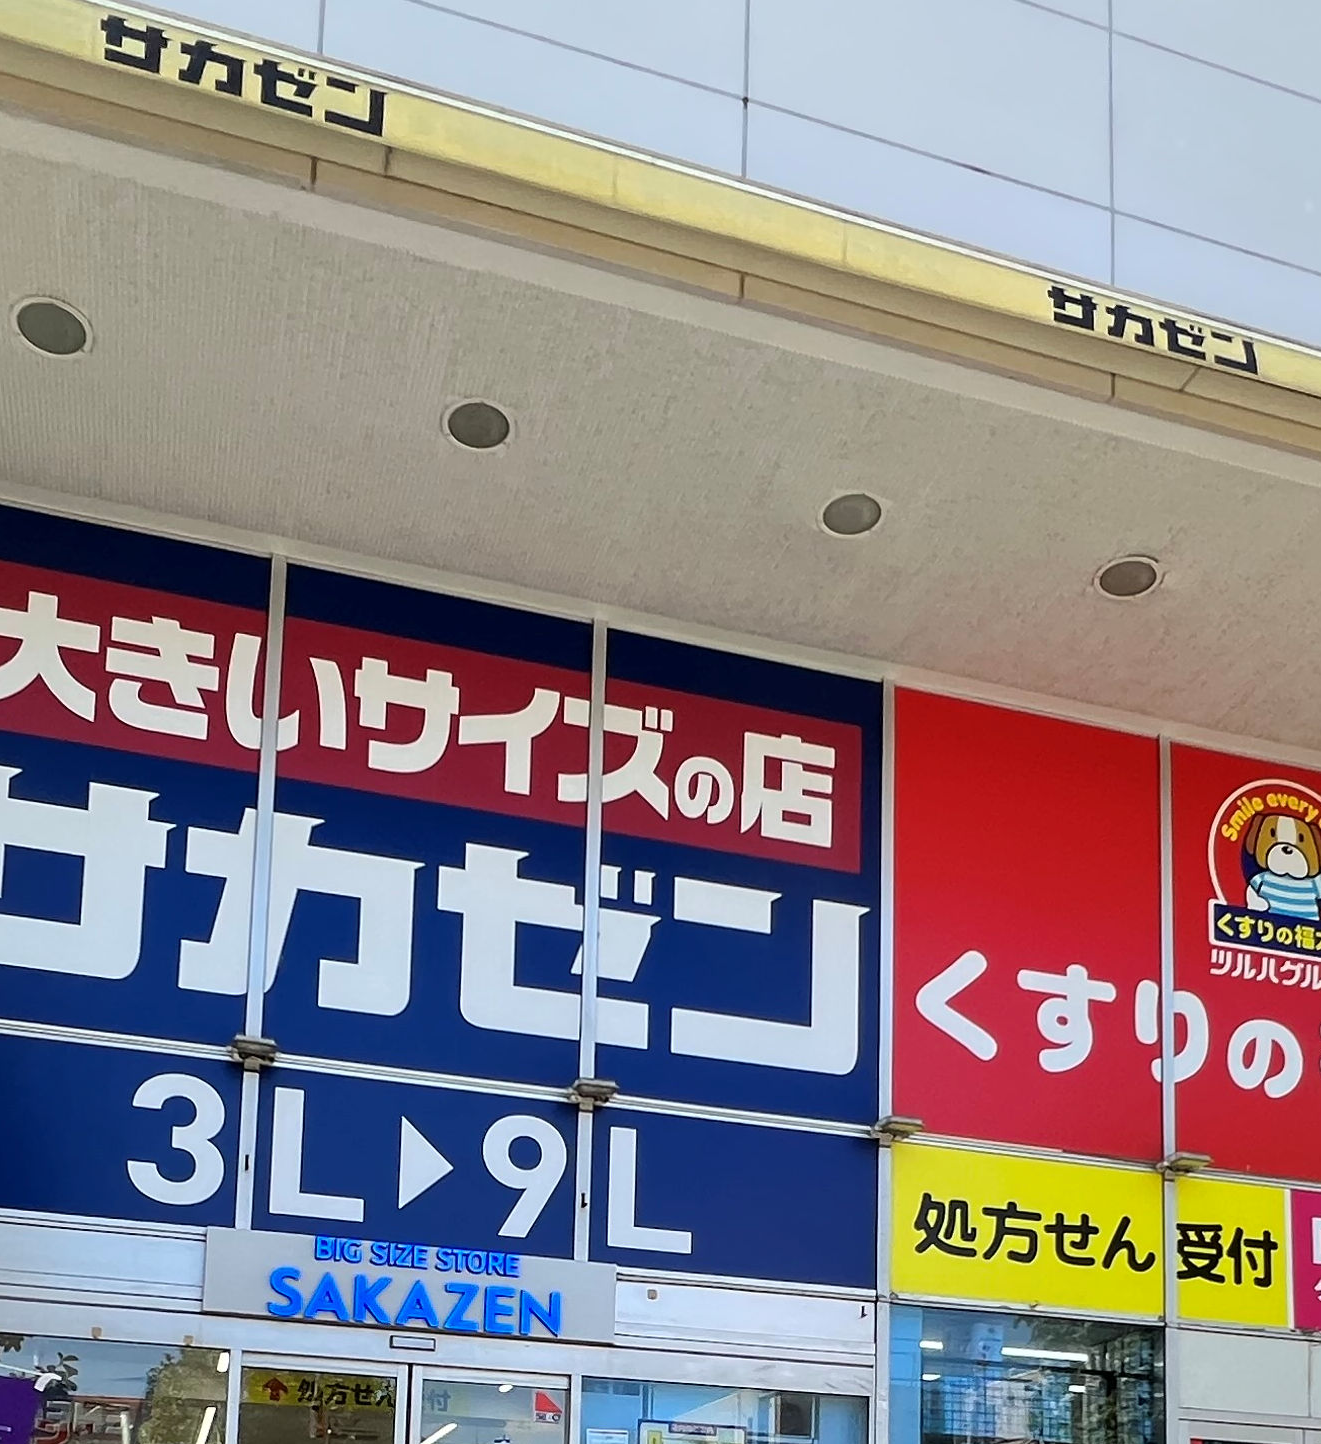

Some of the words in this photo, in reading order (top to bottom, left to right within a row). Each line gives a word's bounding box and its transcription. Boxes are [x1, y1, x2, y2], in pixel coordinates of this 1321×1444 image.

[99, 13, 387, 137] サカゼン
[1046, 284, 1259, 376] サカゼン
[1221, 796, 1265, 842] Smile
[1266, 792, 1319, 823] every
[315, 1236, 362, 1265] BIG
[370, 1240, 428, 1272] SIZE
[434, 1246, 521, 1278] STORE
[268, 1267, 562, 1338] SAKAZEN
